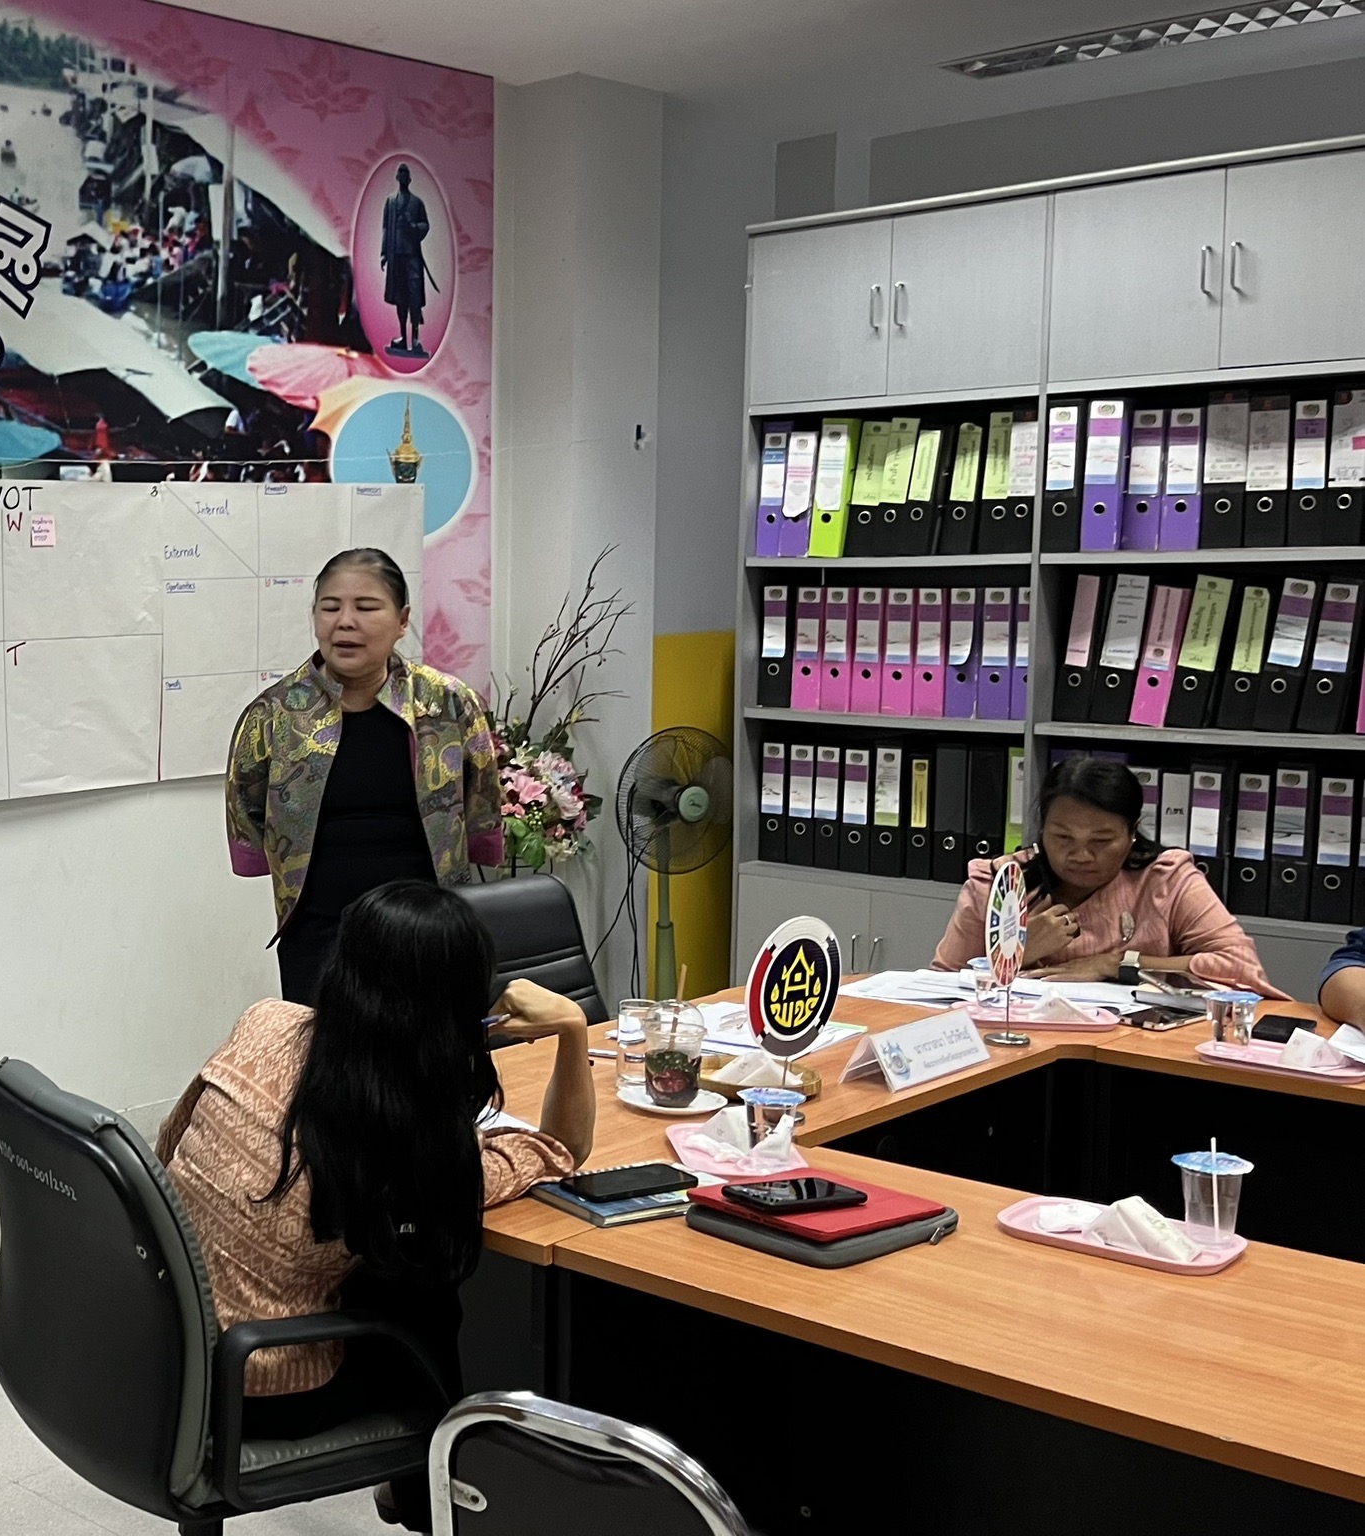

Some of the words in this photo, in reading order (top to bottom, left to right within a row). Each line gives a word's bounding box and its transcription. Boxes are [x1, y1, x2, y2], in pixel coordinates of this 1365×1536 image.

[195, 499, 230, 516] Internal
[5, 511, 24, 532] W
[164, 543, 201, 560] External
[6, 640, 27, 667] T
